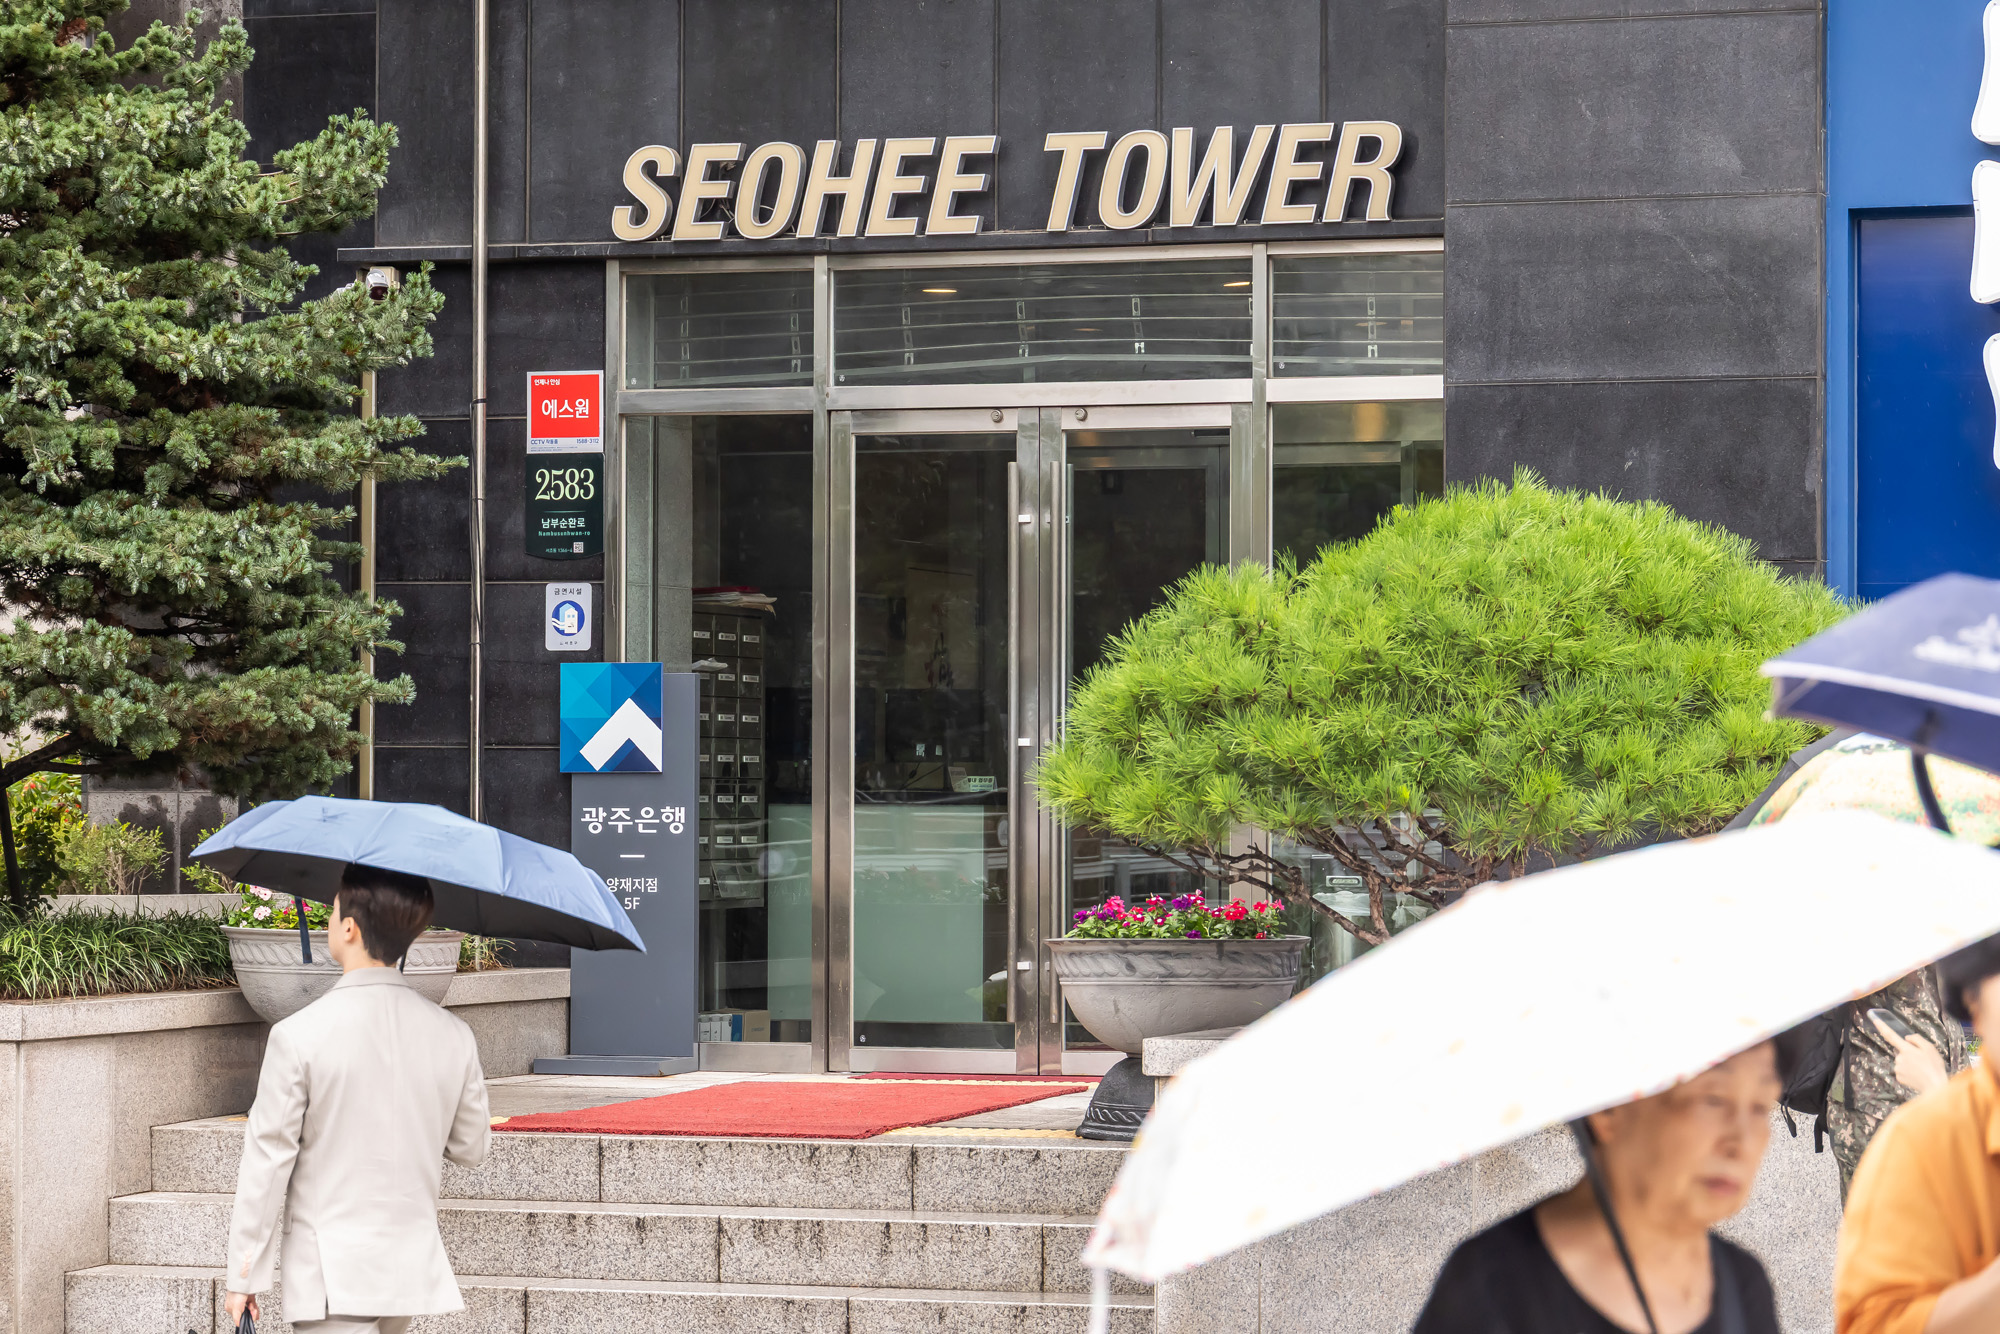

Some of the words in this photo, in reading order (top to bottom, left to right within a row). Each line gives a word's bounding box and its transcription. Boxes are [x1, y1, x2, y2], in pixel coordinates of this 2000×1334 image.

[611, 134, 1001, 241] SEOHEE
[1043, 120, 1404, 231] TOWER
[541, 398, 589, 418] 에스원
[535, 468, 595, 501] 2583
[541, 517, 586, 529] 남부순환로
[553, 587, 582, 596] 금연시설
[580, 806, 686, 835] 광주은행
[606, 877, 658, 893] 양재지점
[624, 897, 641, 910] 5F
